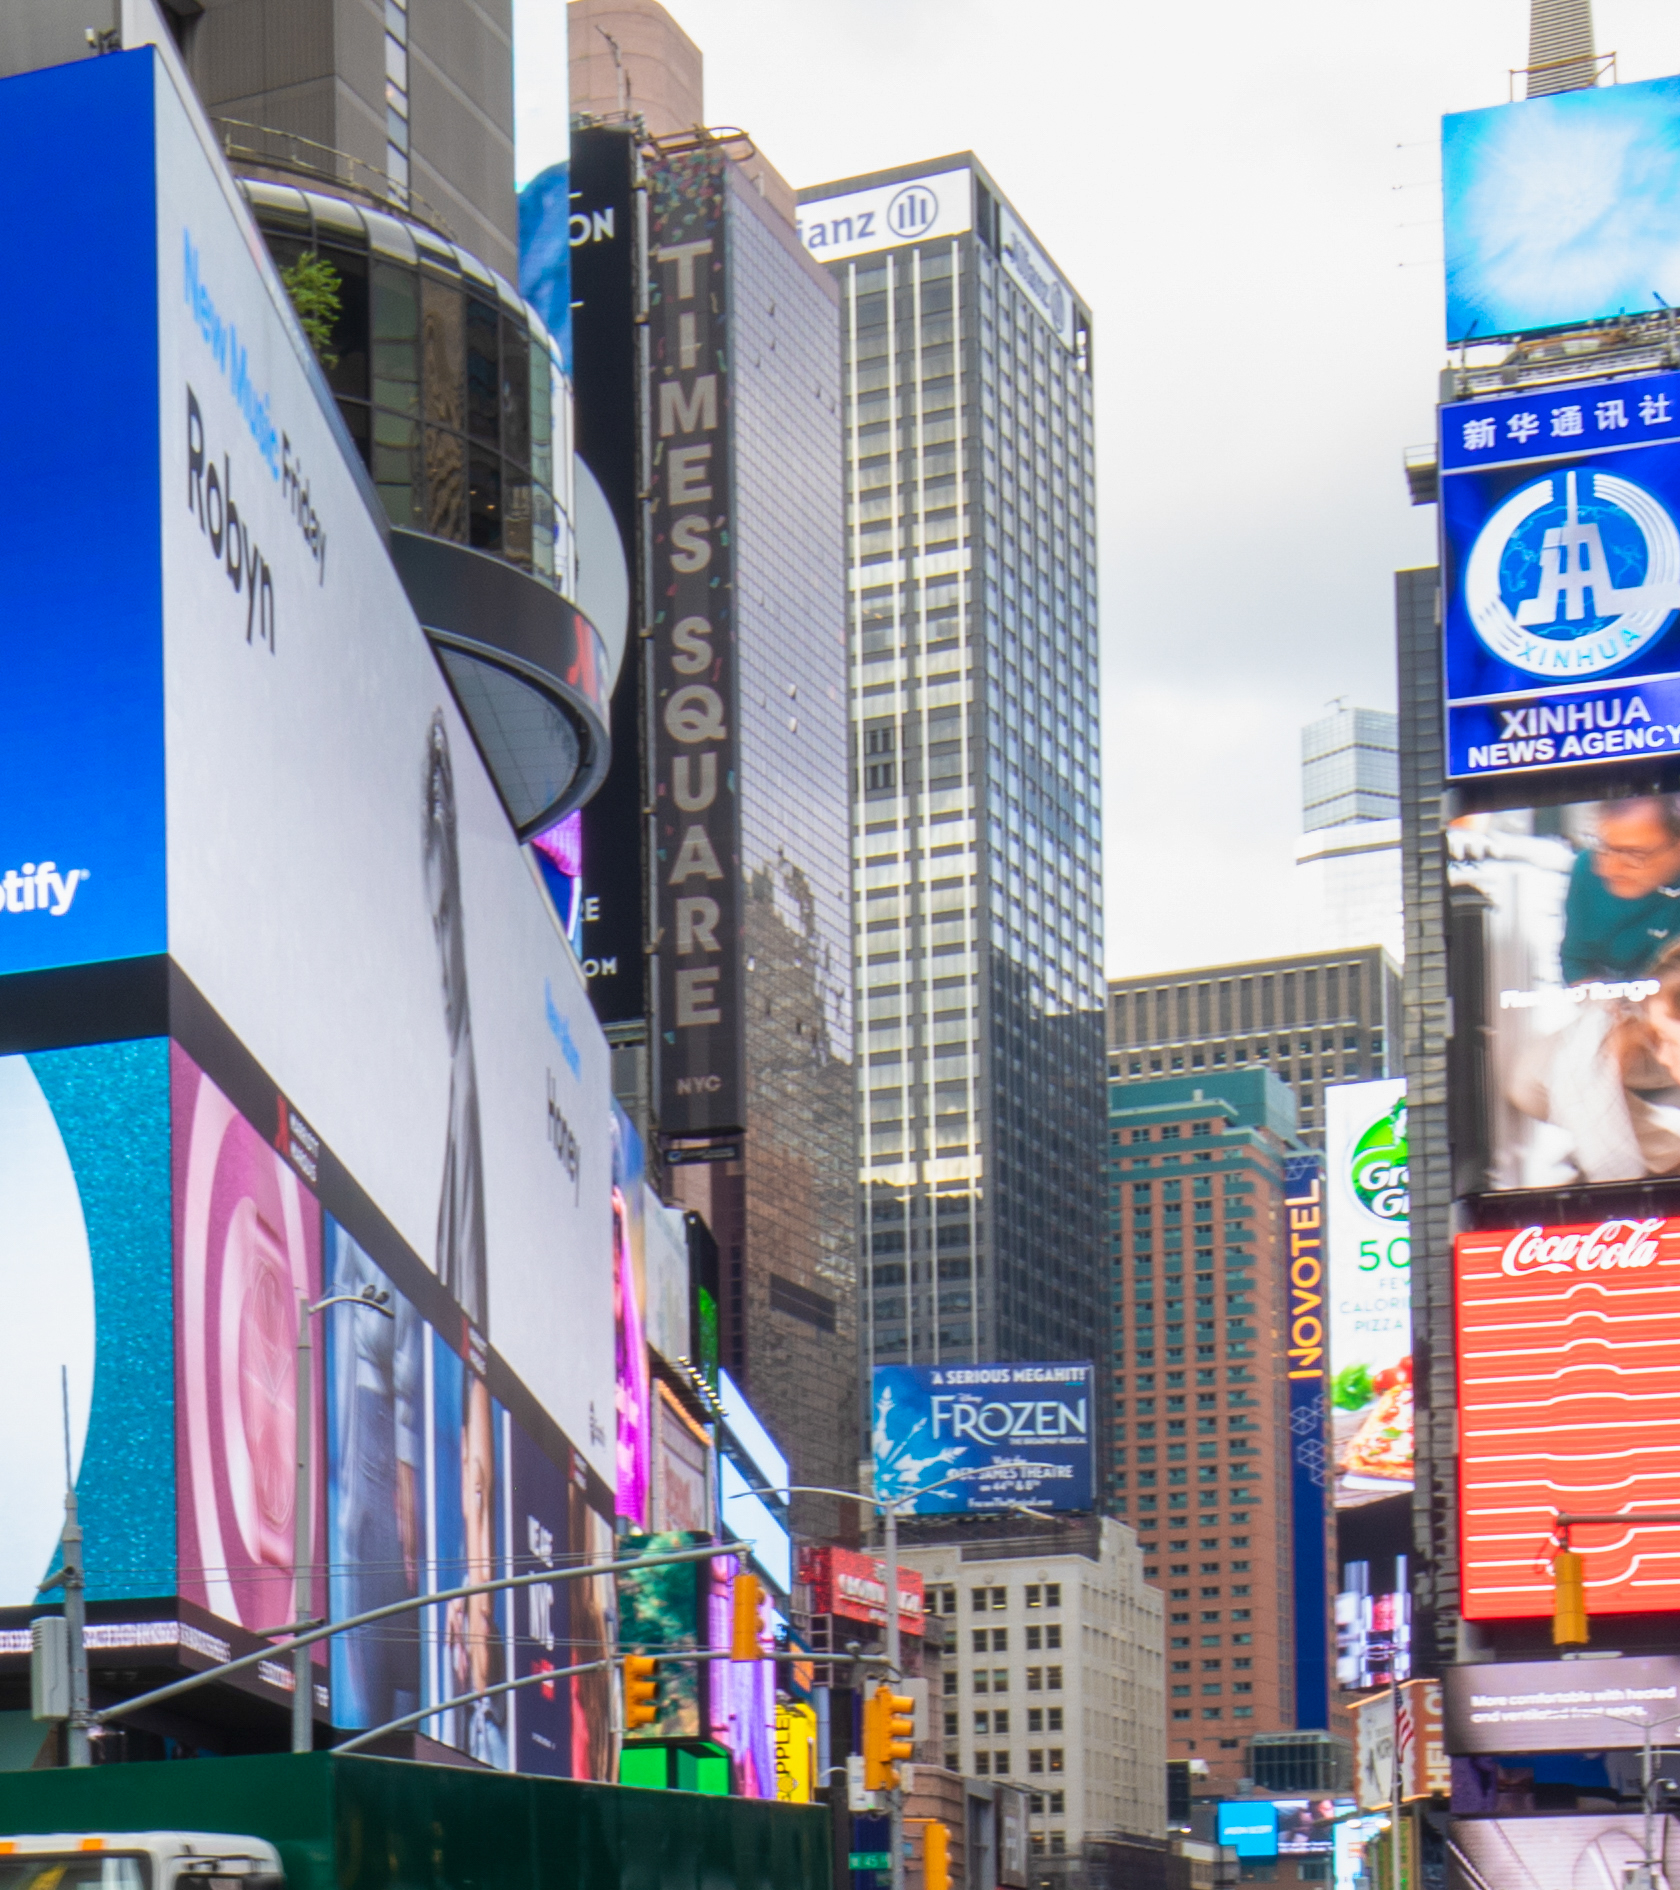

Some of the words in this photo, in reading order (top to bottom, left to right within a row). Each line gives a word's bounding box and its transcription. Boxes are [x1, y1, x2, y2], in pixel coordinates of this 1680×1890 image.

[655, 239, 719, 573] TIMES
[1462, 392, 1673, 451] 新华通讯社
[185, 381, 276, 656] Robyn
[281, 429, 327, 588] Friday
[1516, 625, 1642, 668] XINHUA
[1499, 695, 1652, 741] XINHUA
[1467, 737, 1556, 768] NEWS
[664, 614, 727, 1028] SQUARE
[676, 1075, 722, 1096] NYC
[1284, 1178, 1324, 1380] NOVOTEL
[946, 1368, 1011, 1385] SERIOUS
[930, 1395, 1087, 1446] FROZEN
